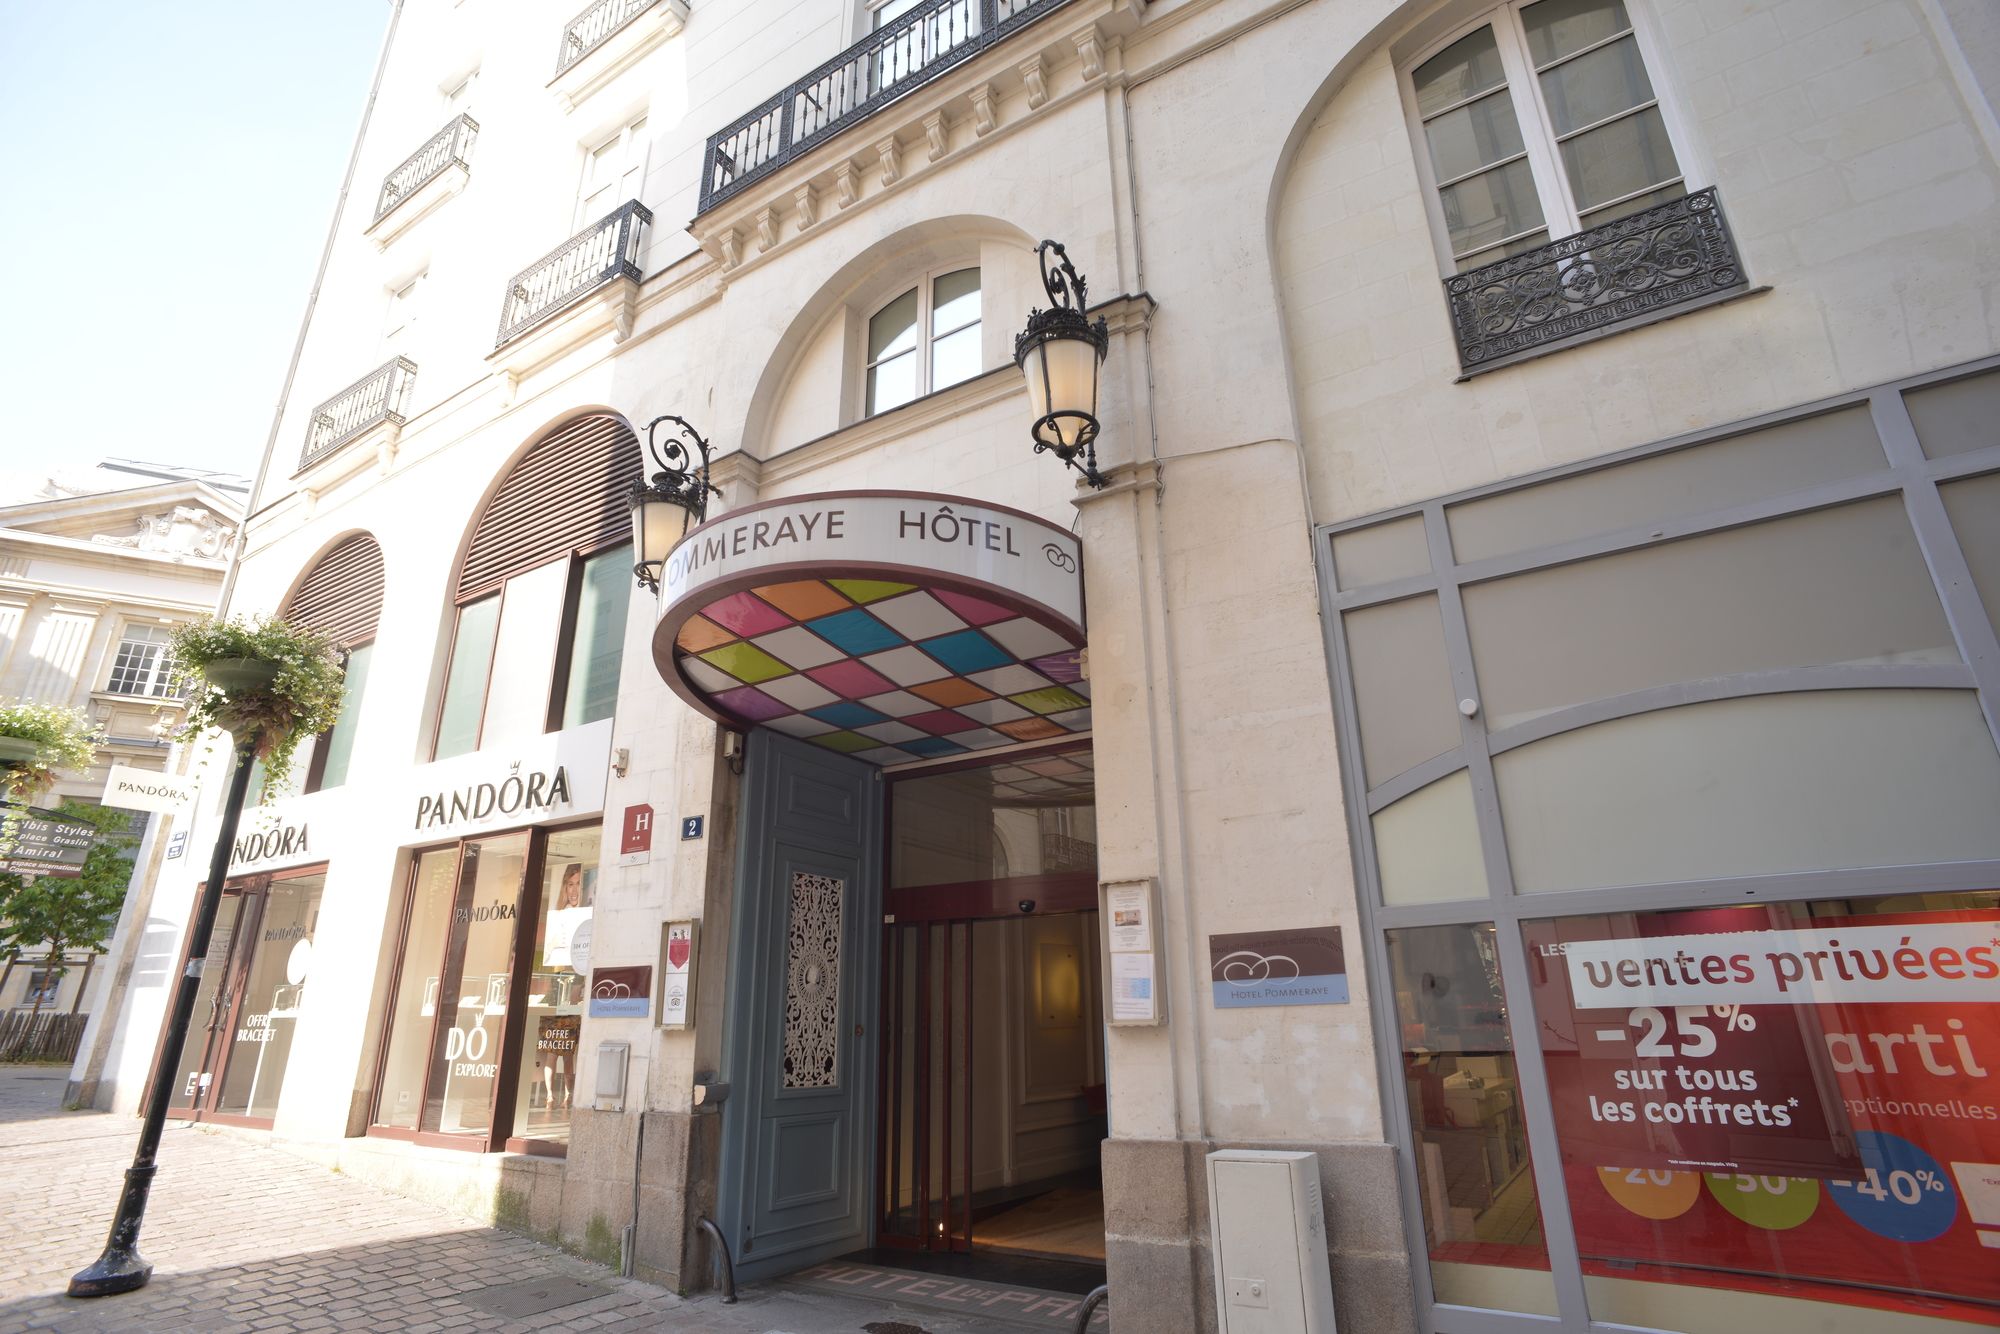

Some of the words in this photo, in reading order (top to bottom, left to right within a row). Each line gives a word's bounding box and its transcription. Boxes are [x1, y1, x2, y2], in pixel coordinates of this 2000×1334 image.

[668, 510, 845, 587] OMMERAYE
[899, 505, 1021, 557] HÔTEL
[635, 812, 650, 832] H
[688, 819, 698, 836] 2
[55, 824, 95, 837] Styles
[18, 833, 48, 842] place
[53, 836, 89, 847] Graslin
[231, 821, 308, 865] NDORA
[14, 845, 64, 858] Amiral
[11, 860, 37, 868] espace
[37, 863, 82, 872] international
[1539, 943, 1568, 957] LES
[1582, 950, 1755, 989] ventes
[1231, 990, 1263, 1000] HOTEL
[1264, 986, 1329, 998] POMMERAYE
[236, 1028, 277, 1042] BRACELET
[545, 1029, 569, 1039] OFFRE
[1595, 1004, 1757, 1058] -25%
[538, 1040, 575, 1050] BRACELET
[1614, 1068, 1667, 1090] sur
[1675, 1065, 1758, 1091] tous
[1588, 1095, 1637, 1122] les
[1831, 1168, 1945, 1205] -40%
